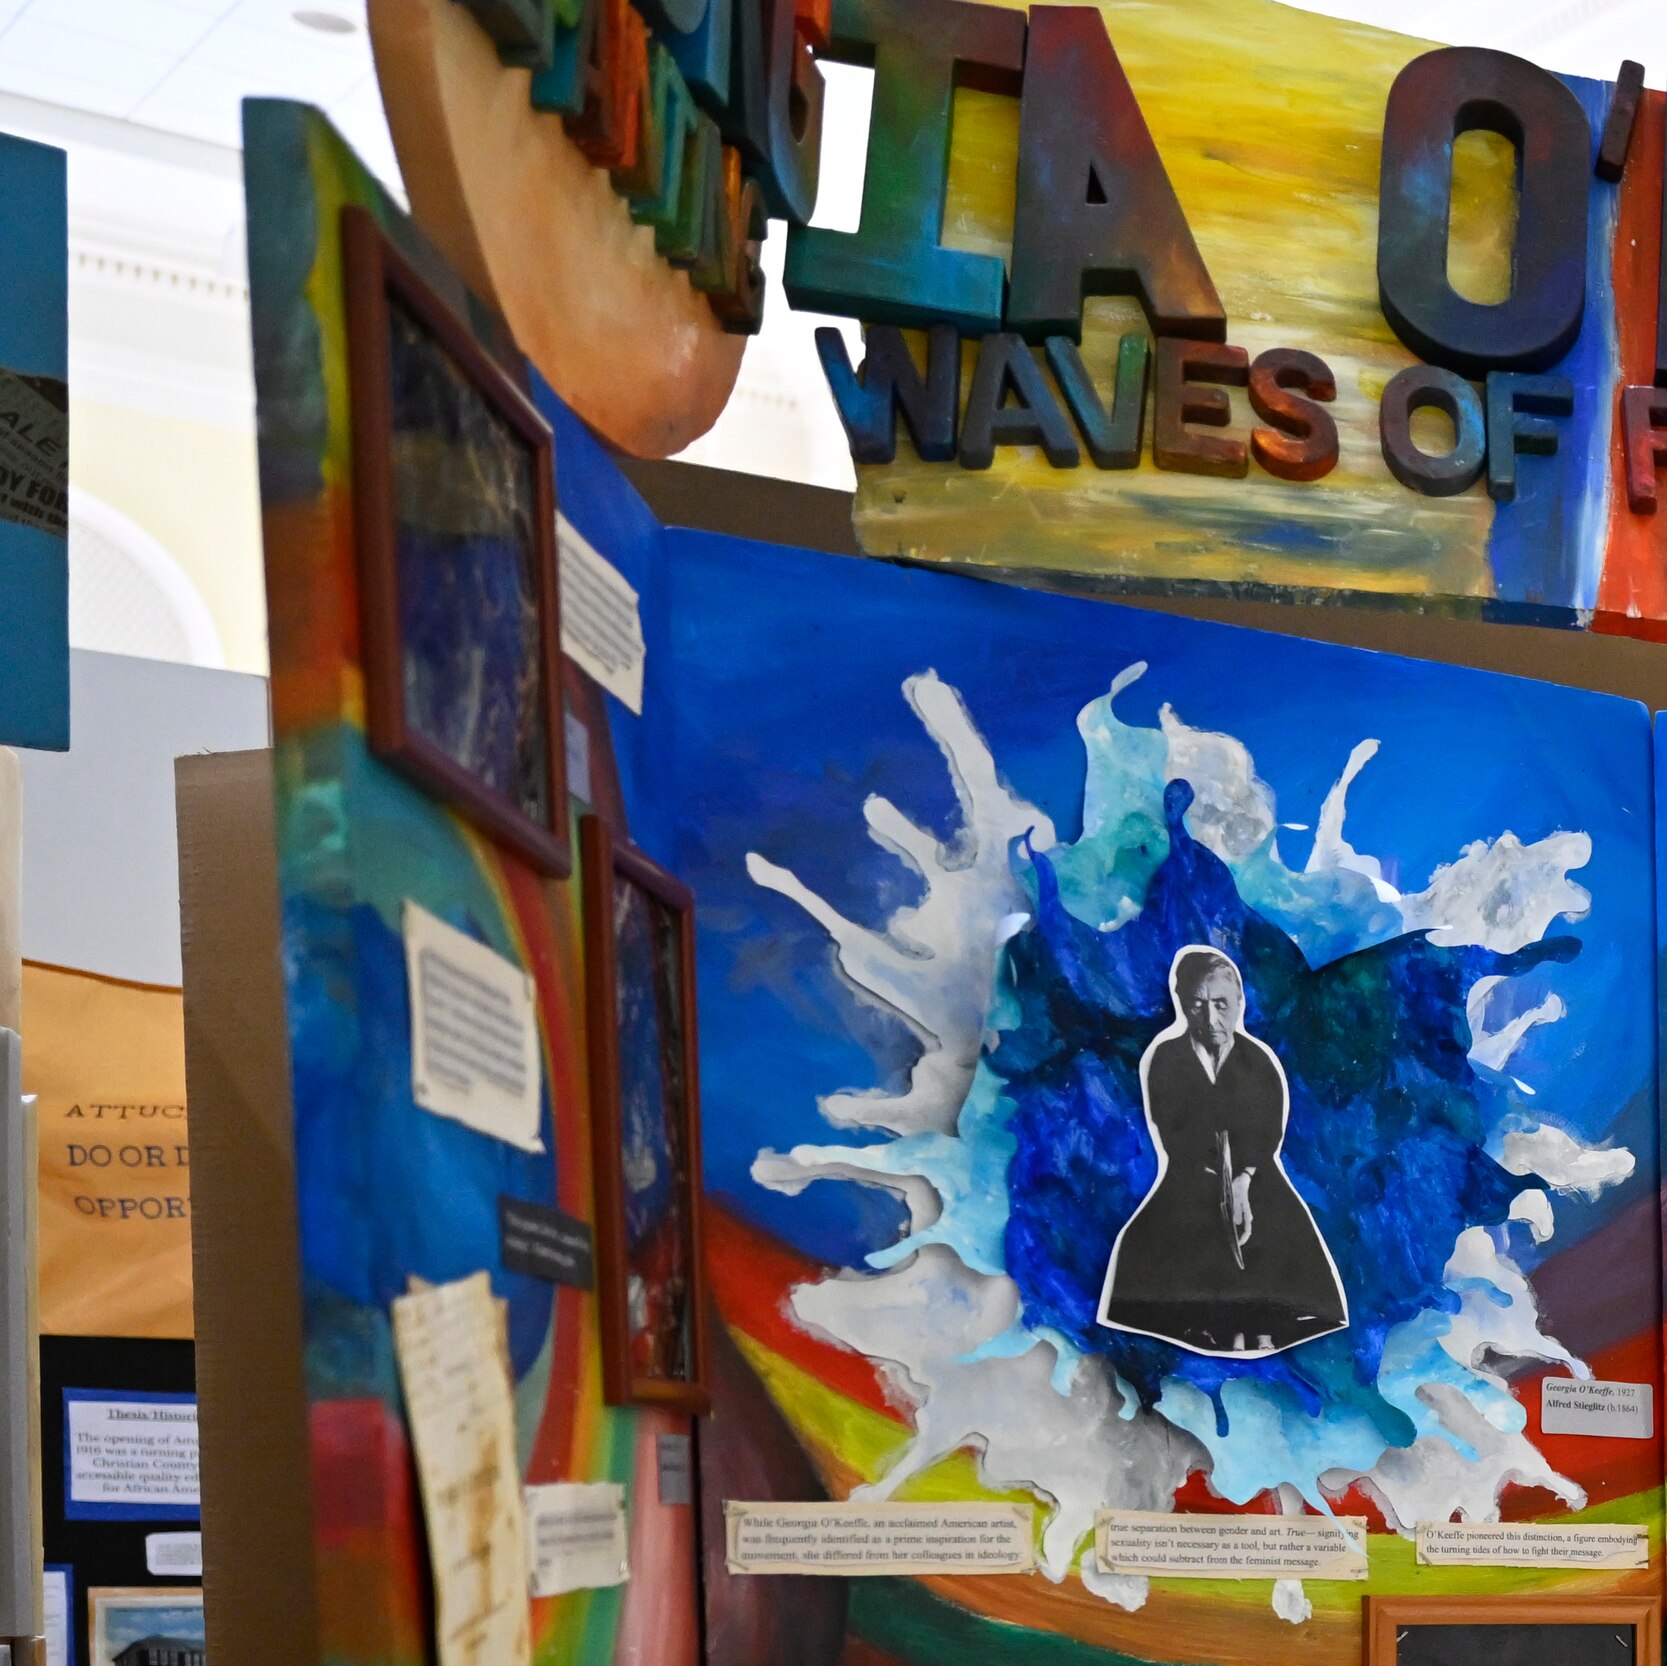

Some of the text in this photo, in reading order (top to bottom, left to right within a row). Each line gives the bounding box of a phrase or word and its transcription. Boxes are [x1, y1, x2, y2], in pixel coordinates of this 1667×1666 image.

[814, 326, 1339, 481] WAVES
[1380, 364, 1574, 503] OF
[65, 1104, 187, 1119] ATTUC
[75, 1196, 189, 1220] OPPOR
